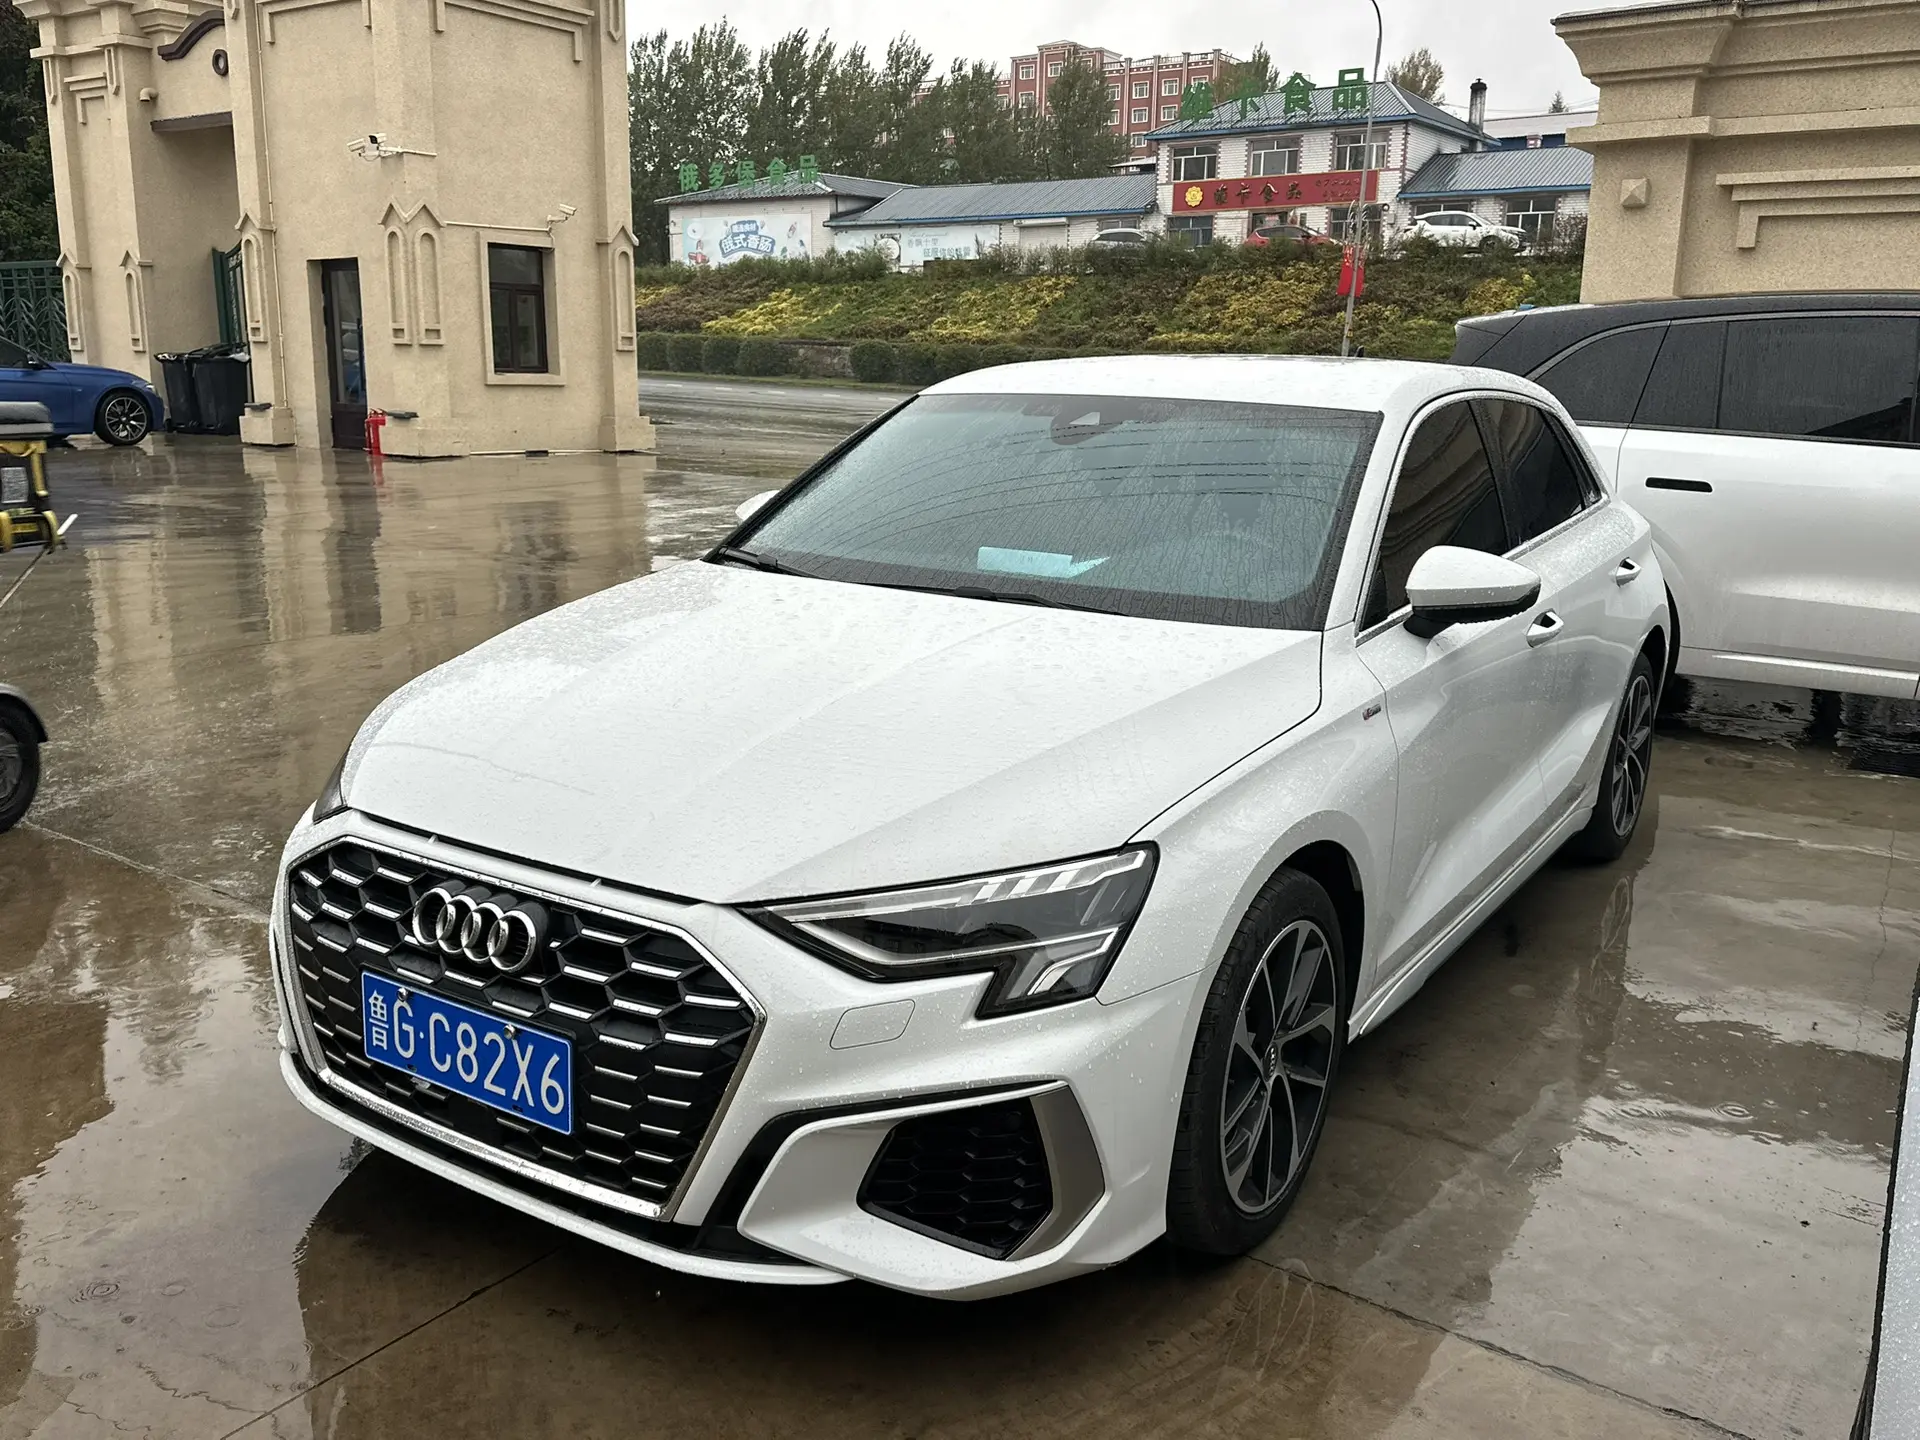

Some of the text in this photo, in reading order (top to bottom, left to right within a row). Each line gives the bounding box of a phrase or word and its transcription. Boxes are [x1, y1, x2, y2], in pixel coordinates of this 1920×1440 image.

[679, 154, 820, 192] 俄多堡食品
[721, 233, 773, 254] 俄式香肠
